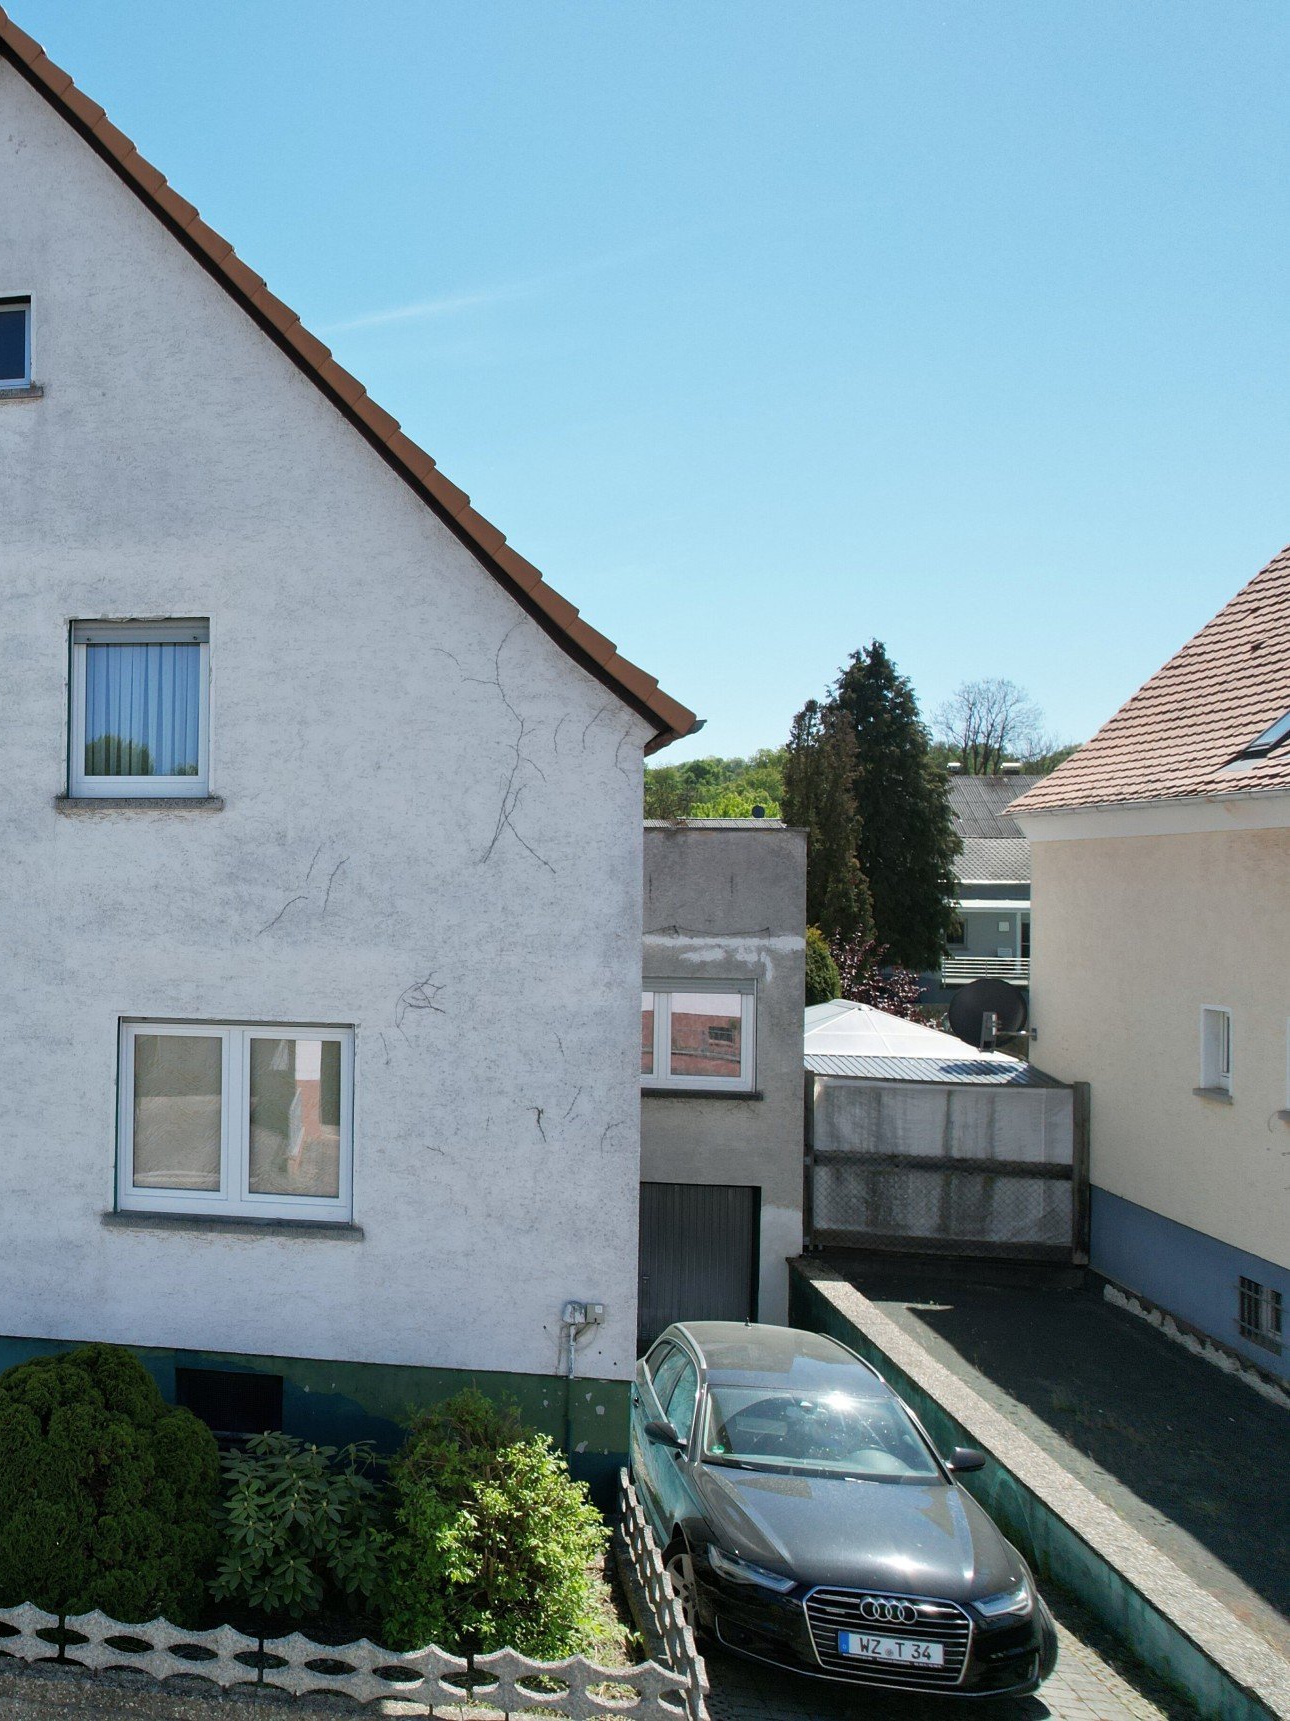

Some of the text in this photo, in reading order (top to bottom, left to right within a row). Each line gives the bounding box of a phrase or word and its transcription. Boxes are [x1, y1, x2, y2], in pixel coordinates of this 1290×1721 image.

[859, 1637, 881, 1655] WZ
[895, 1642, 905, 1658] T
[911, 1643, 931, 1660] 34
